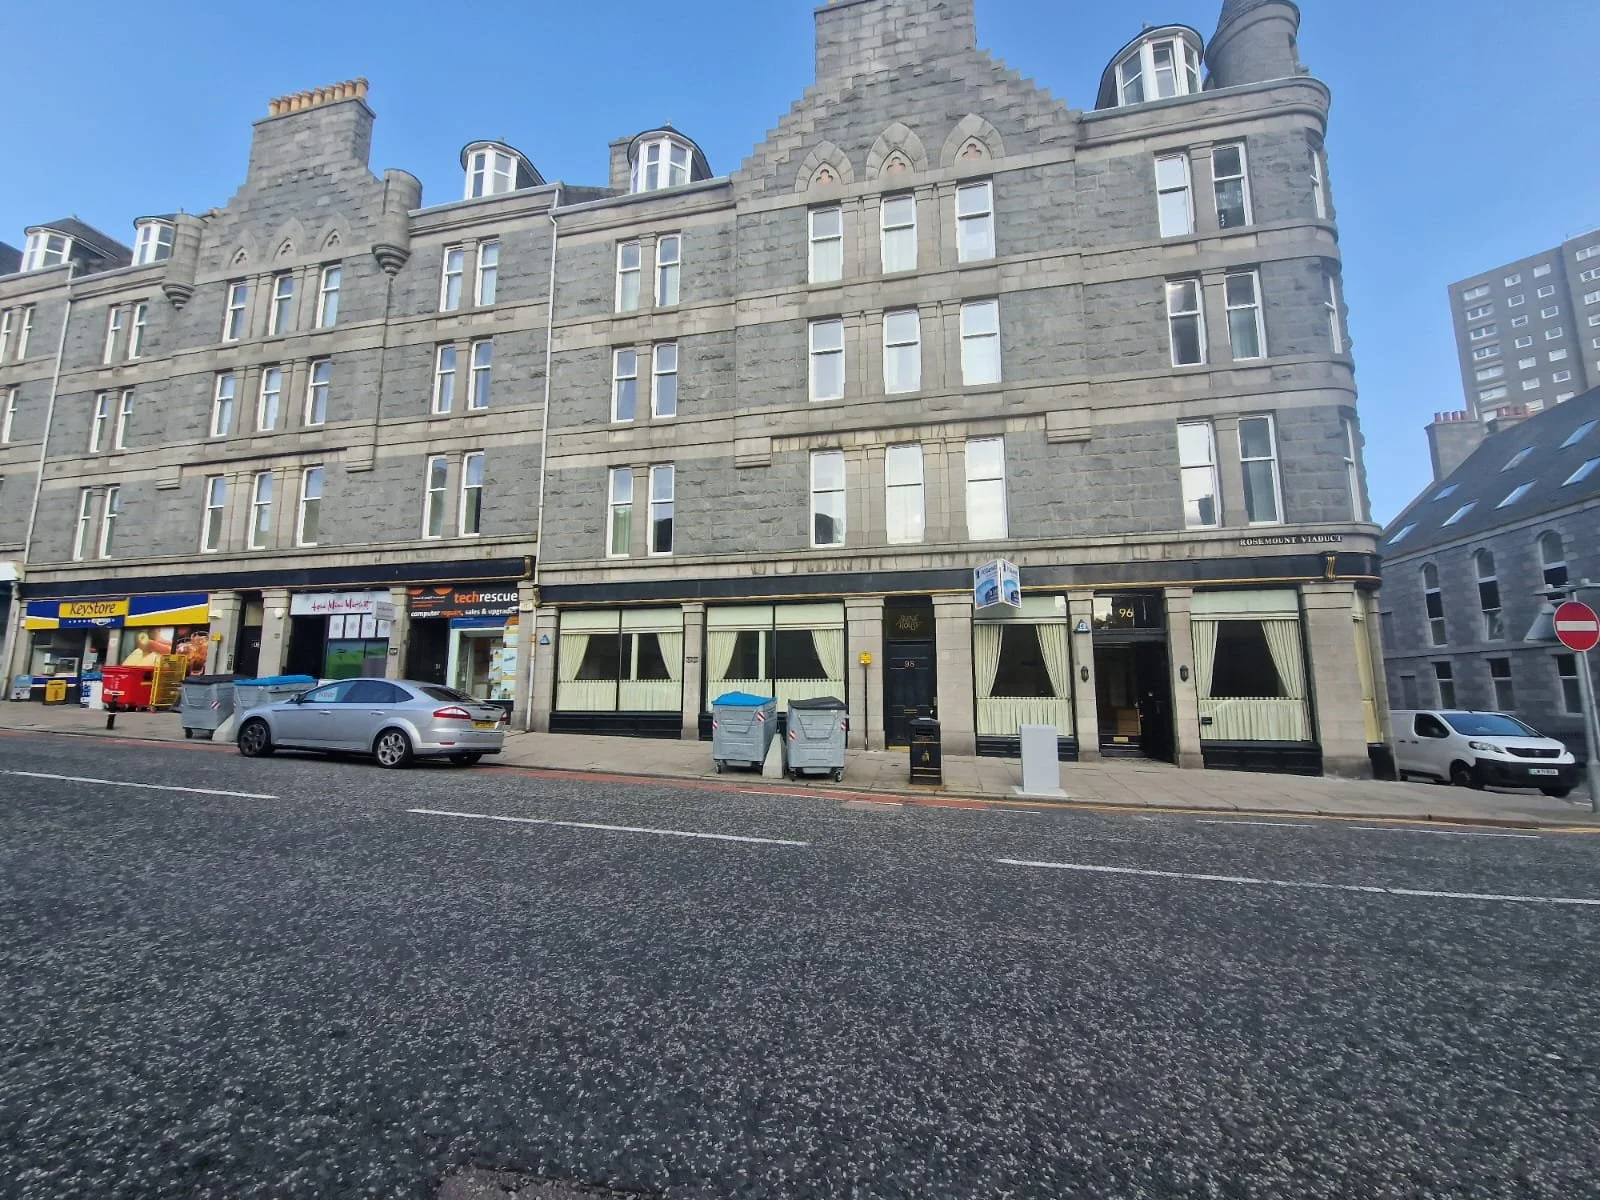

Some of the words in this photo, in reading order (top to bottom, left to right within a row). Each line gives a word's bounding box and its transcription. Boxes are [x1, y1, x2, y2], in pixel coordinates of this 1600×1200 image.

[1240, 536, 1297, 546] ROSEMOUNT
[1300, 534, 1343, 543] VIADUCT
[454, 590, 519, 604] techrescue
[410, 610, 441, 619] computer
[1119, 608, 1134, 618] 96
